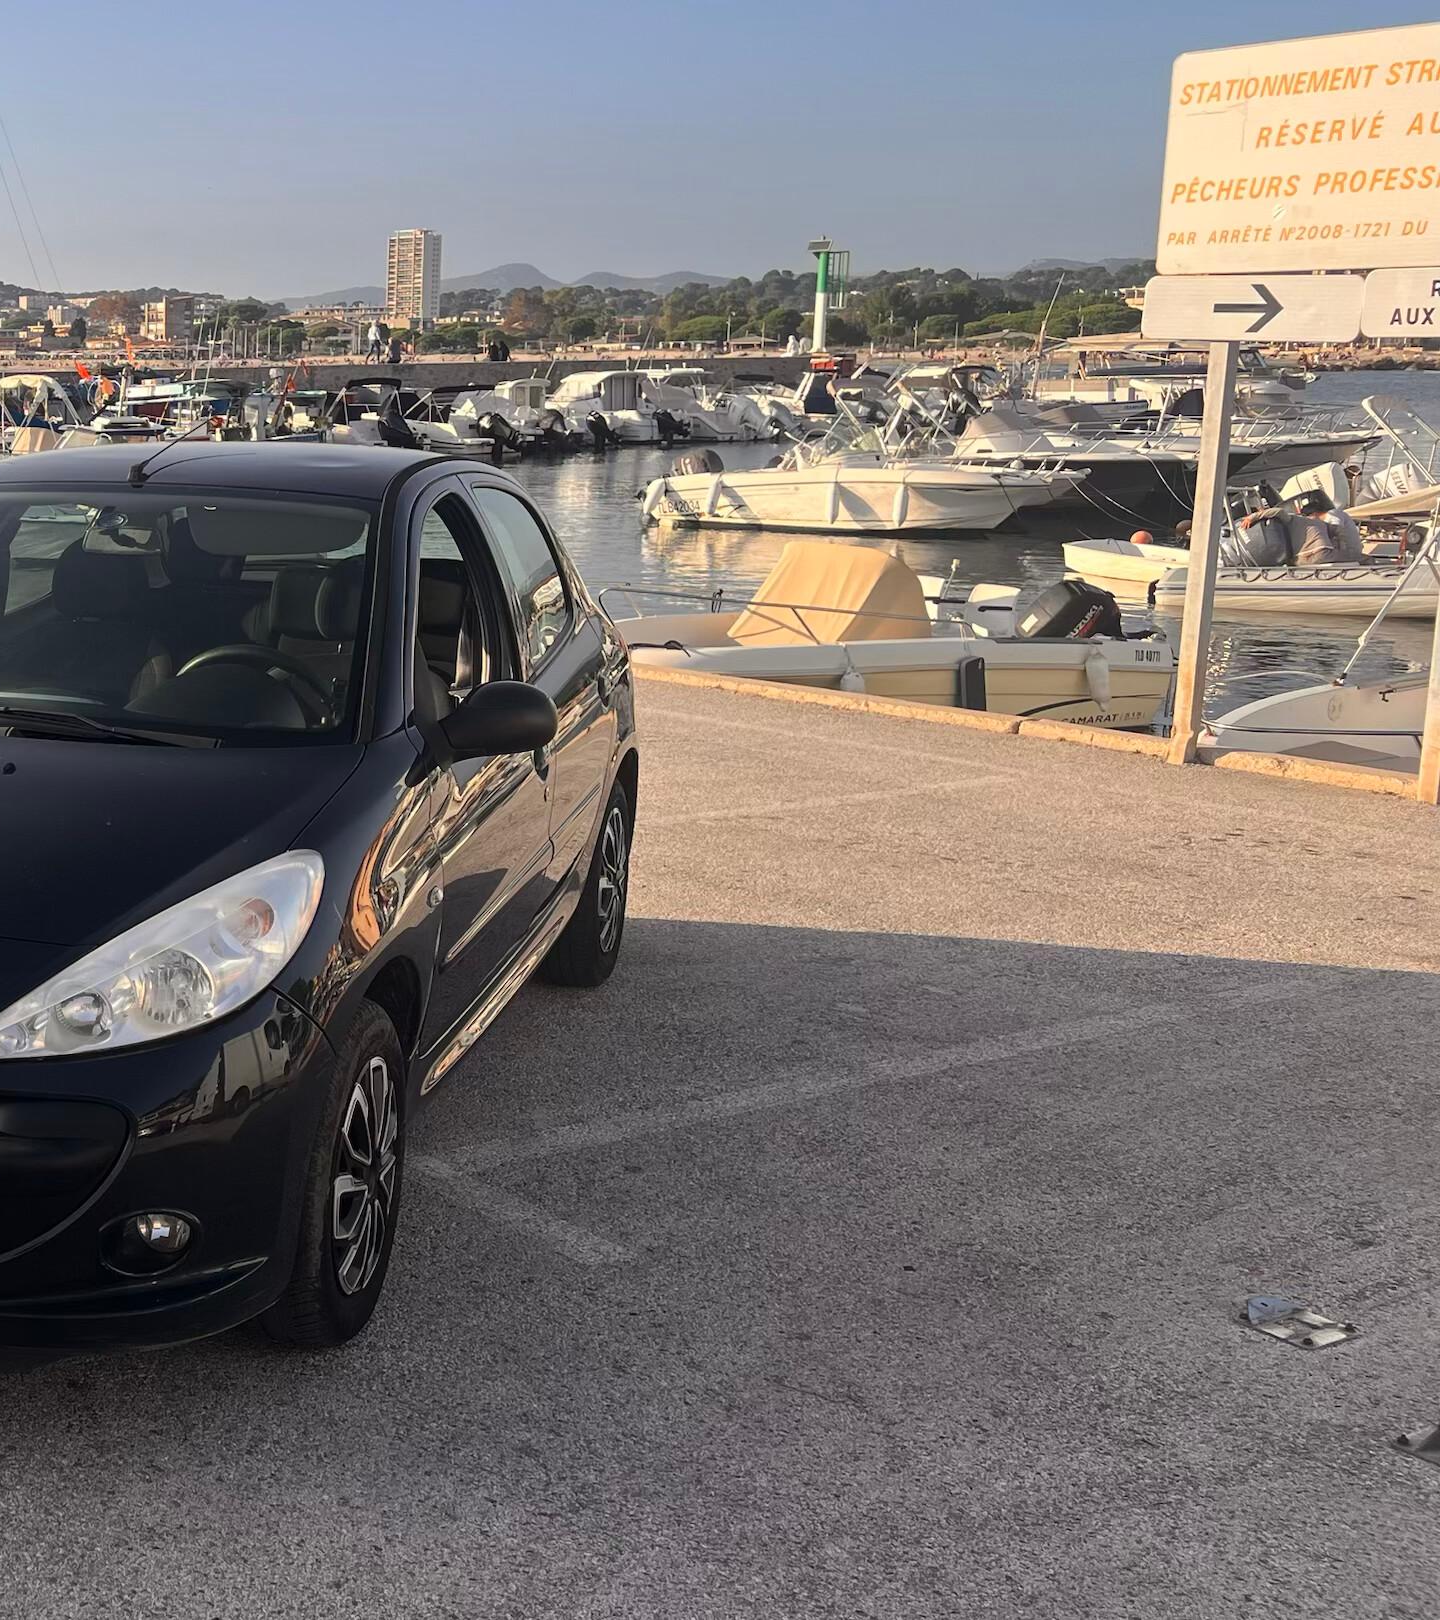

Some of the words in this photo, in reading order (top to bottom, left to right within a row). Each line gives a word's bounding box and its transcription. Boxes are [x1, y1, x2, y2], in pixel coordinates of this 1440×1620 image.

[1180, 64, 1378, 105] STATIONNEMENT
[1255, 110, 1386, 149] RÉSERVÉ
[1170, 174, 1301, 204] PÊCHEURS
[1166, 231, 1197, 246] PAR
[1207, 225, 1273, 244] ARRÊTÉ
[1401, 220, 1429, 236] DU
[1390, 307, 1436, 325] AUX
